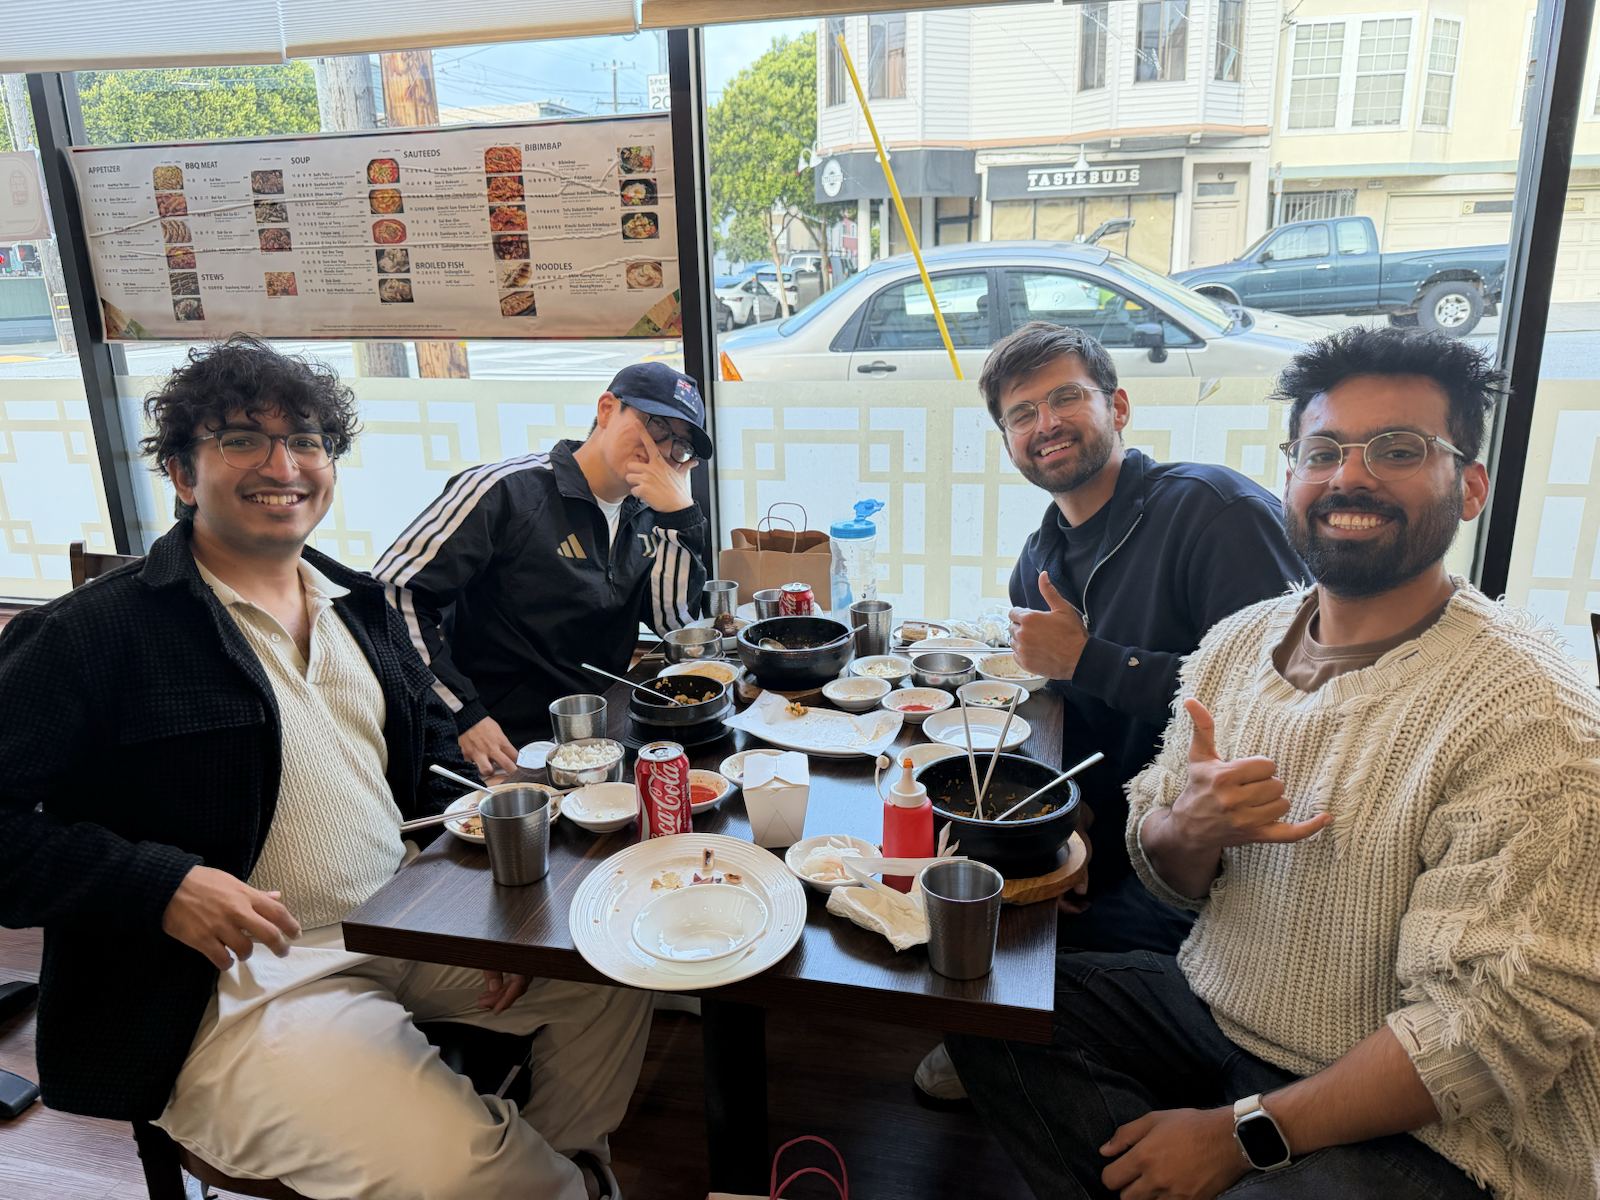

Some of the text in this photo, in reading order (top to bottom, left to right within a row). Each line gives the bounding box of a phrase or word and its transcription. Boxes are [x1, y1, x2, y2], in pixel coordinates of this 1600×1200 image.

[525, 142, 562, 151] BIBIMBAP
[403, 149, 440, 158] SAUTEEDS
[185, 162, 200, 170] BBQ
[200, 161, 218, 169] MEAT
[291, 157, 311, 165] SOUP
[88, 165, 121, 174] APPETIZER
[1027, 169, 1140, 187] TASTEBUDS
[415, 261, 465, 270] BROILED FISH
[535, 262, 573, 271] NOODLES
[201, 273, 225, 281] STEWS
[648, 761, 681, 839] ca-Cola
